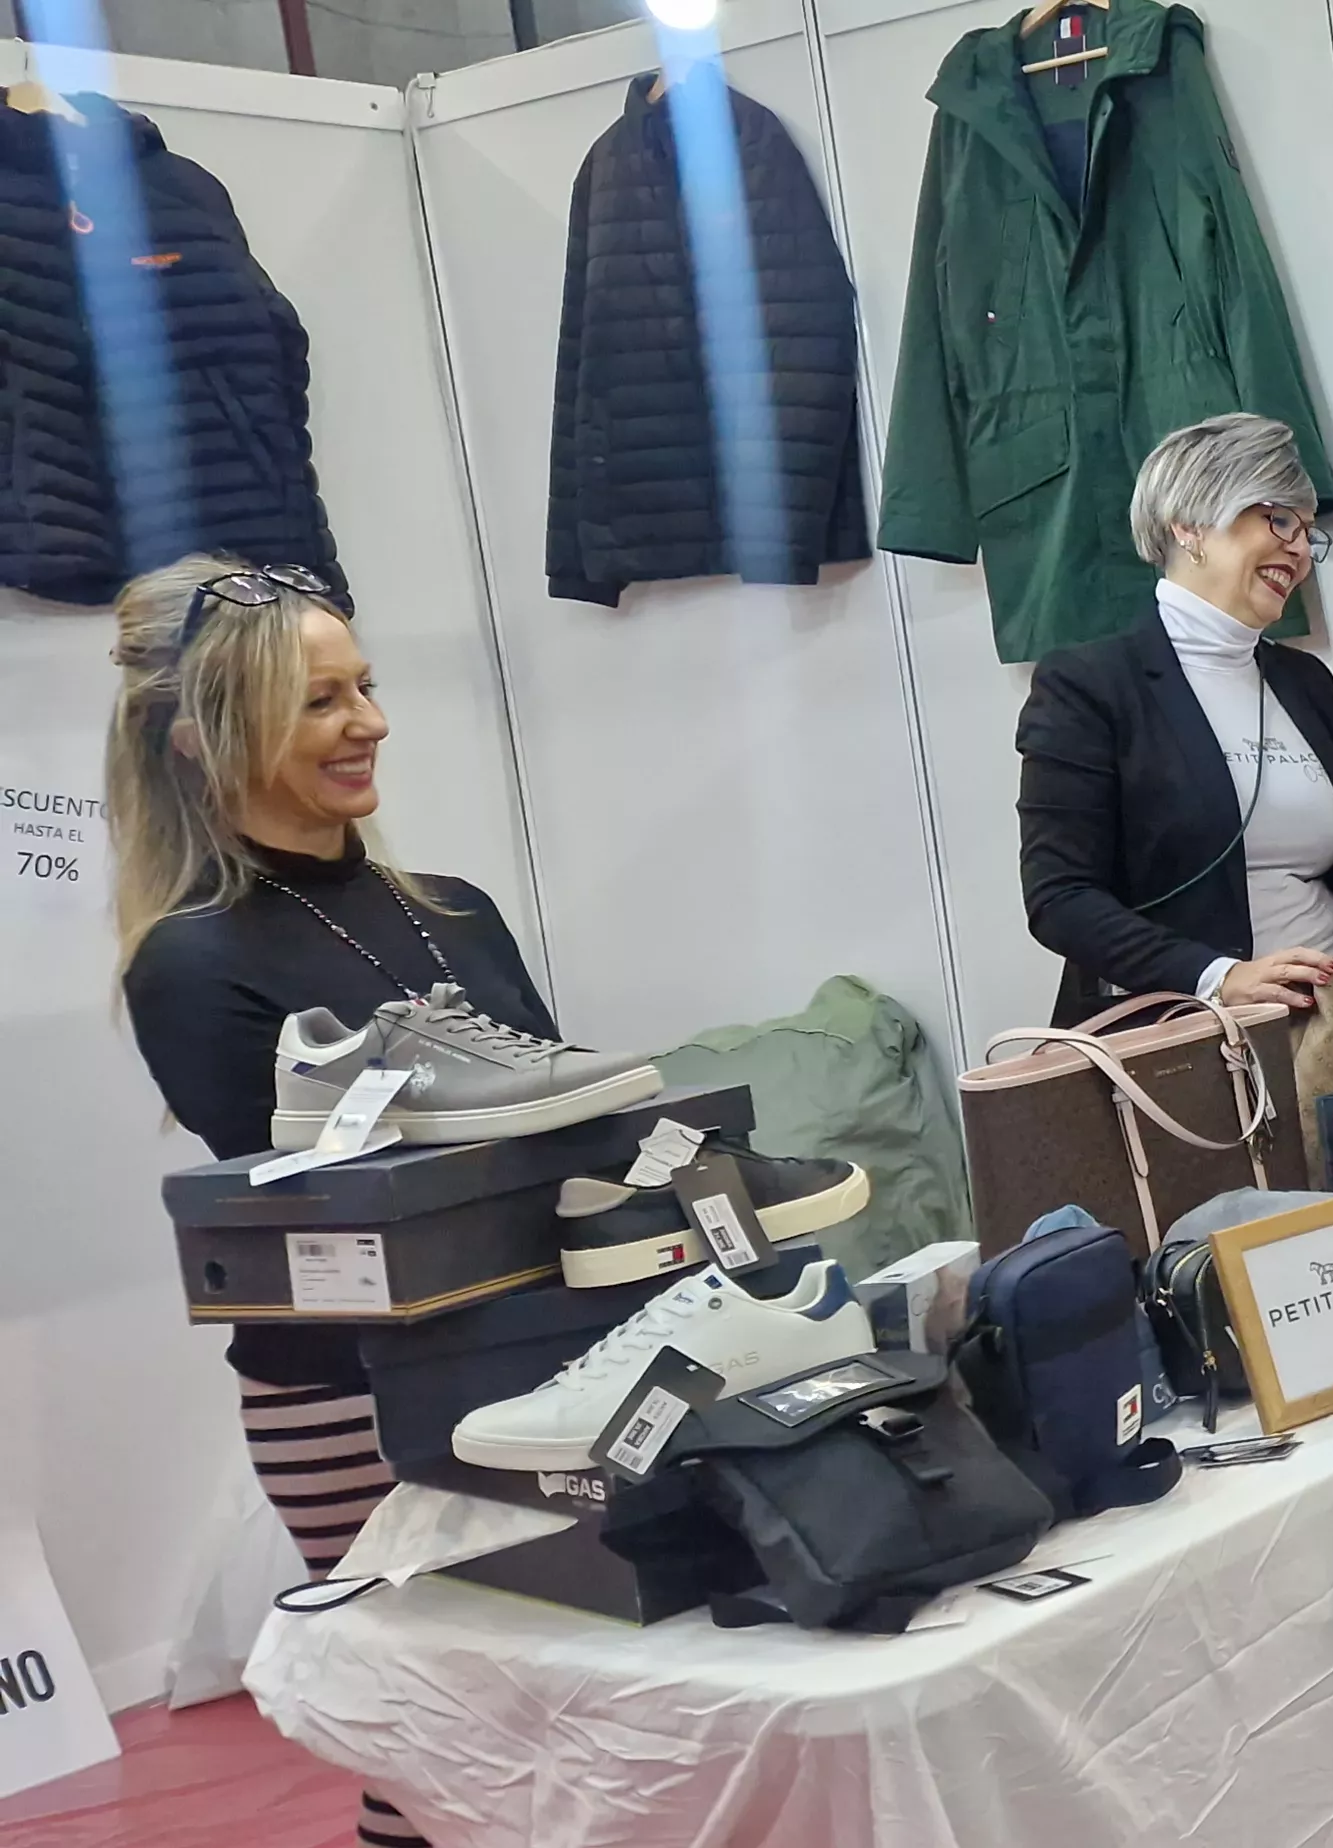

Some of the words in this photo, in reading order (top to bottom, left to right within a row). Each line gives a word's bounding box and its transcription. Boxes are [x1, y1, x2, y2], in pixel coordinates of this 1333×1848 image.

[1223, 751, 1261, 764] ETIT
[1266, 752, 1321, 764] PALAC
[13, 822, 63, 840] HASTA
[68, 828, 85, 844] EL
[17, 850, 79, 882] 70%
[1268, 1291, 1333, 1329] PETIT
[565, 1474, 606, 1502] GAS
